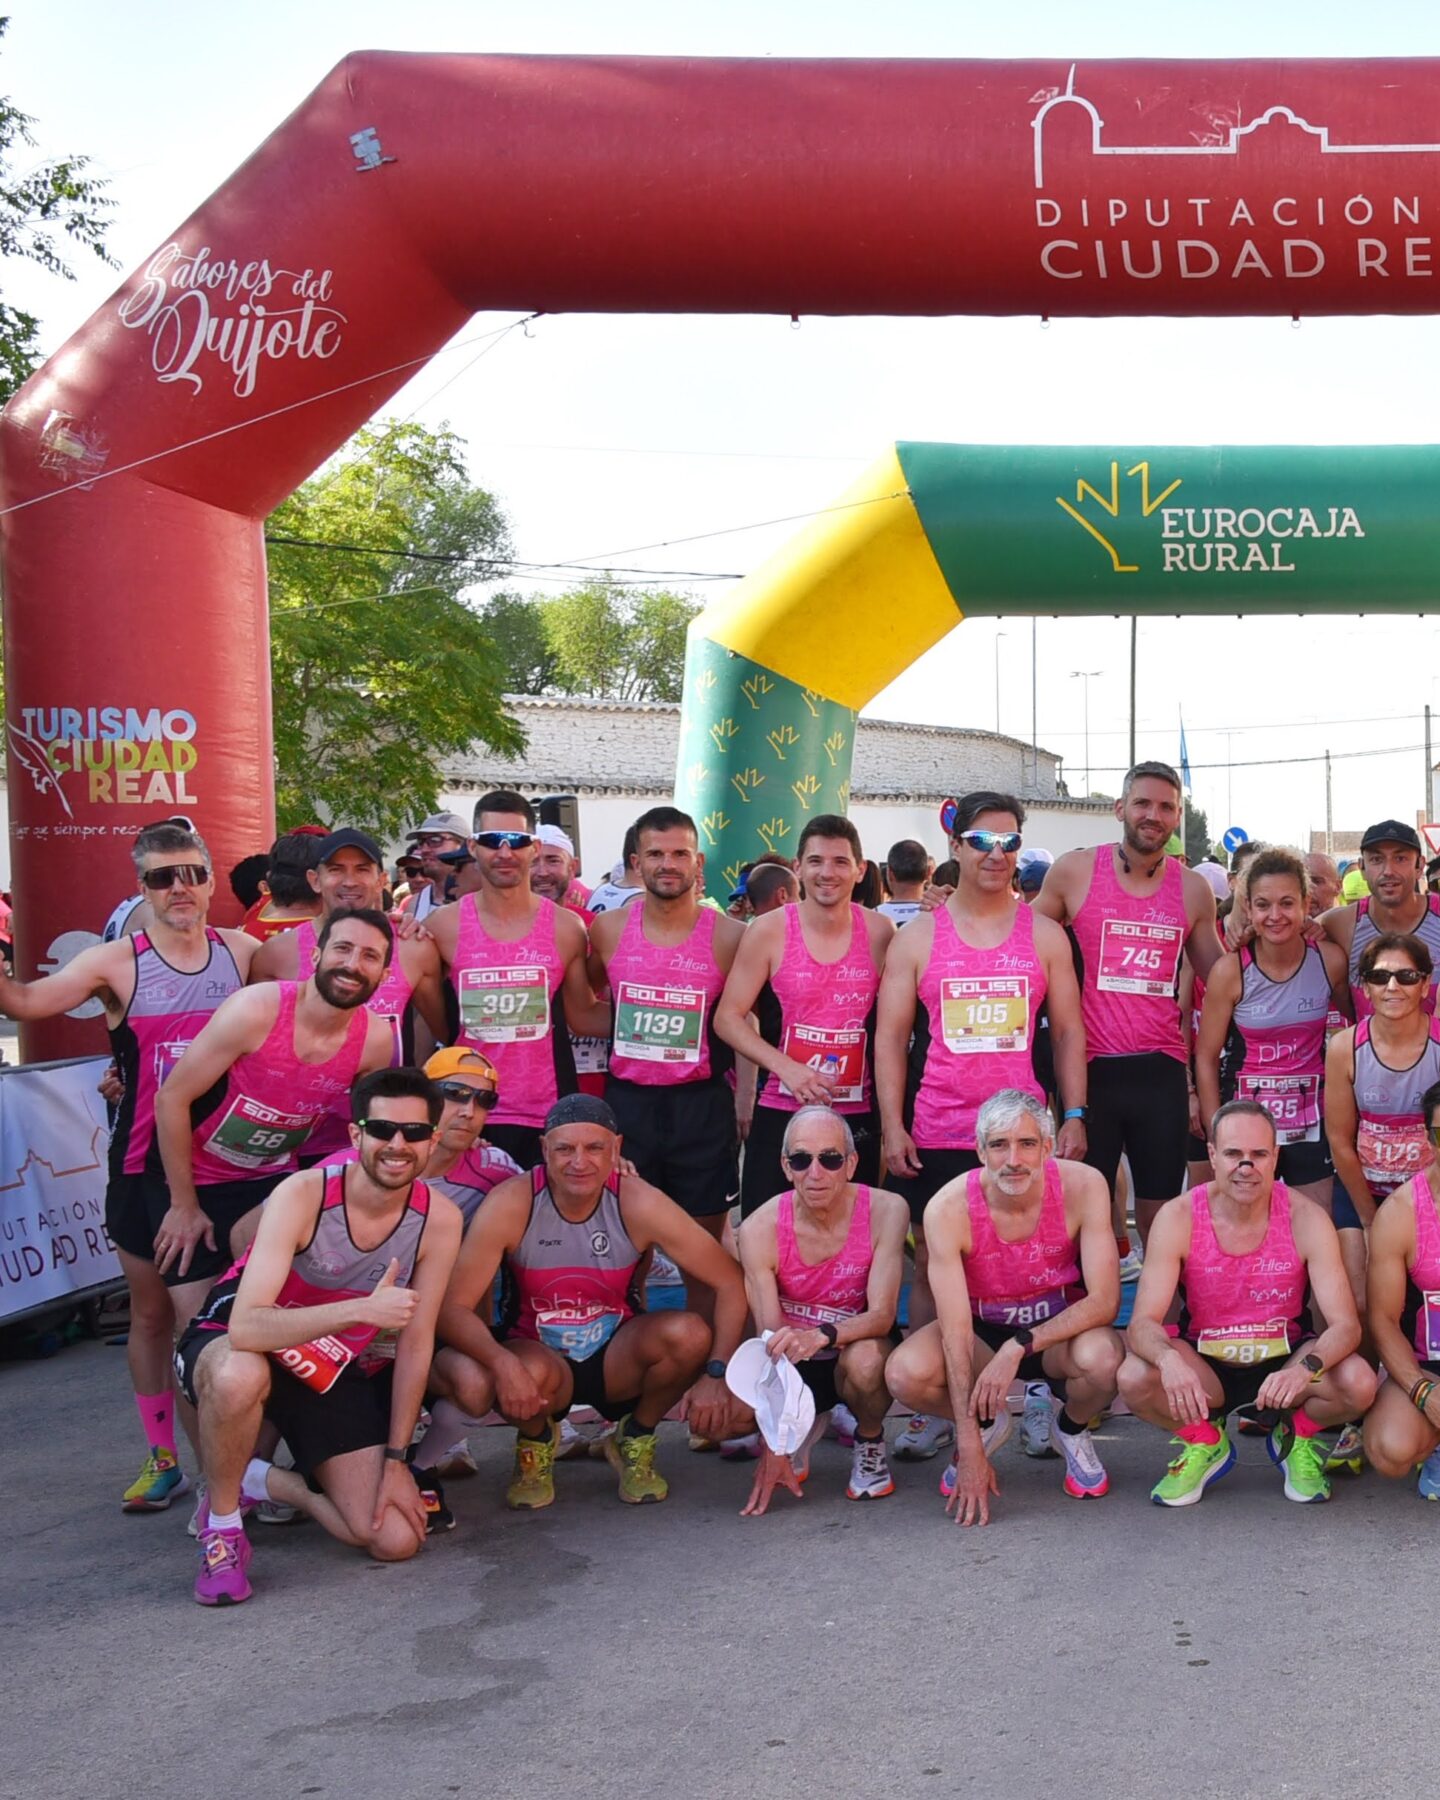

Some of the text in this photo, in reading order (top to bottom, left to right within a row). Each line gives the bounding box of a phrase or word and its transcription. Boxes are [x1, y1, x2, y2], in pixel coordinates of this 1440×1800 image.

[1035, 193, 1421, 228] DIPUTACIÓN
[1039, 238, 1326, 280] CIUDAD
[118, 242, 333, 329] Sabores del
[148, 289, 348, 398] Quijote
[1161, 507, 1365, 538] EUROCAJA
[1162, 542, 1296, 572] RURAL
[21, 706, 197, 743] TURISMO
[46, 738, 198, 773] CIUDAD
[88, 769, 198, 805] REAL
[53, 822, 106, 841] siempre
[1110, 923, 1177, 941] SOLISS
[1121, 946, 1163, 970] 745
[467, 969, 540, 985] SOLISS
[948, 980, 1020, 994] SOLISS
[482, 992, 530, 1015] 307
[625, 986, 697, 1006] SOLISS
[632, 1010, 686, 1036] 1139
[965, 1003, 1009, 1025] 105
[795, 1028, 861, 1045] SOLISS
[247, 1129, 288, 1150] 58
[0, 1224, 118, 1288] UDAD RE
[1249, 1287, 1295, 1303] DESAME
[1002, 1300, 1050, 1325] 780
[1222, 1344, 1269, 1364] 287
